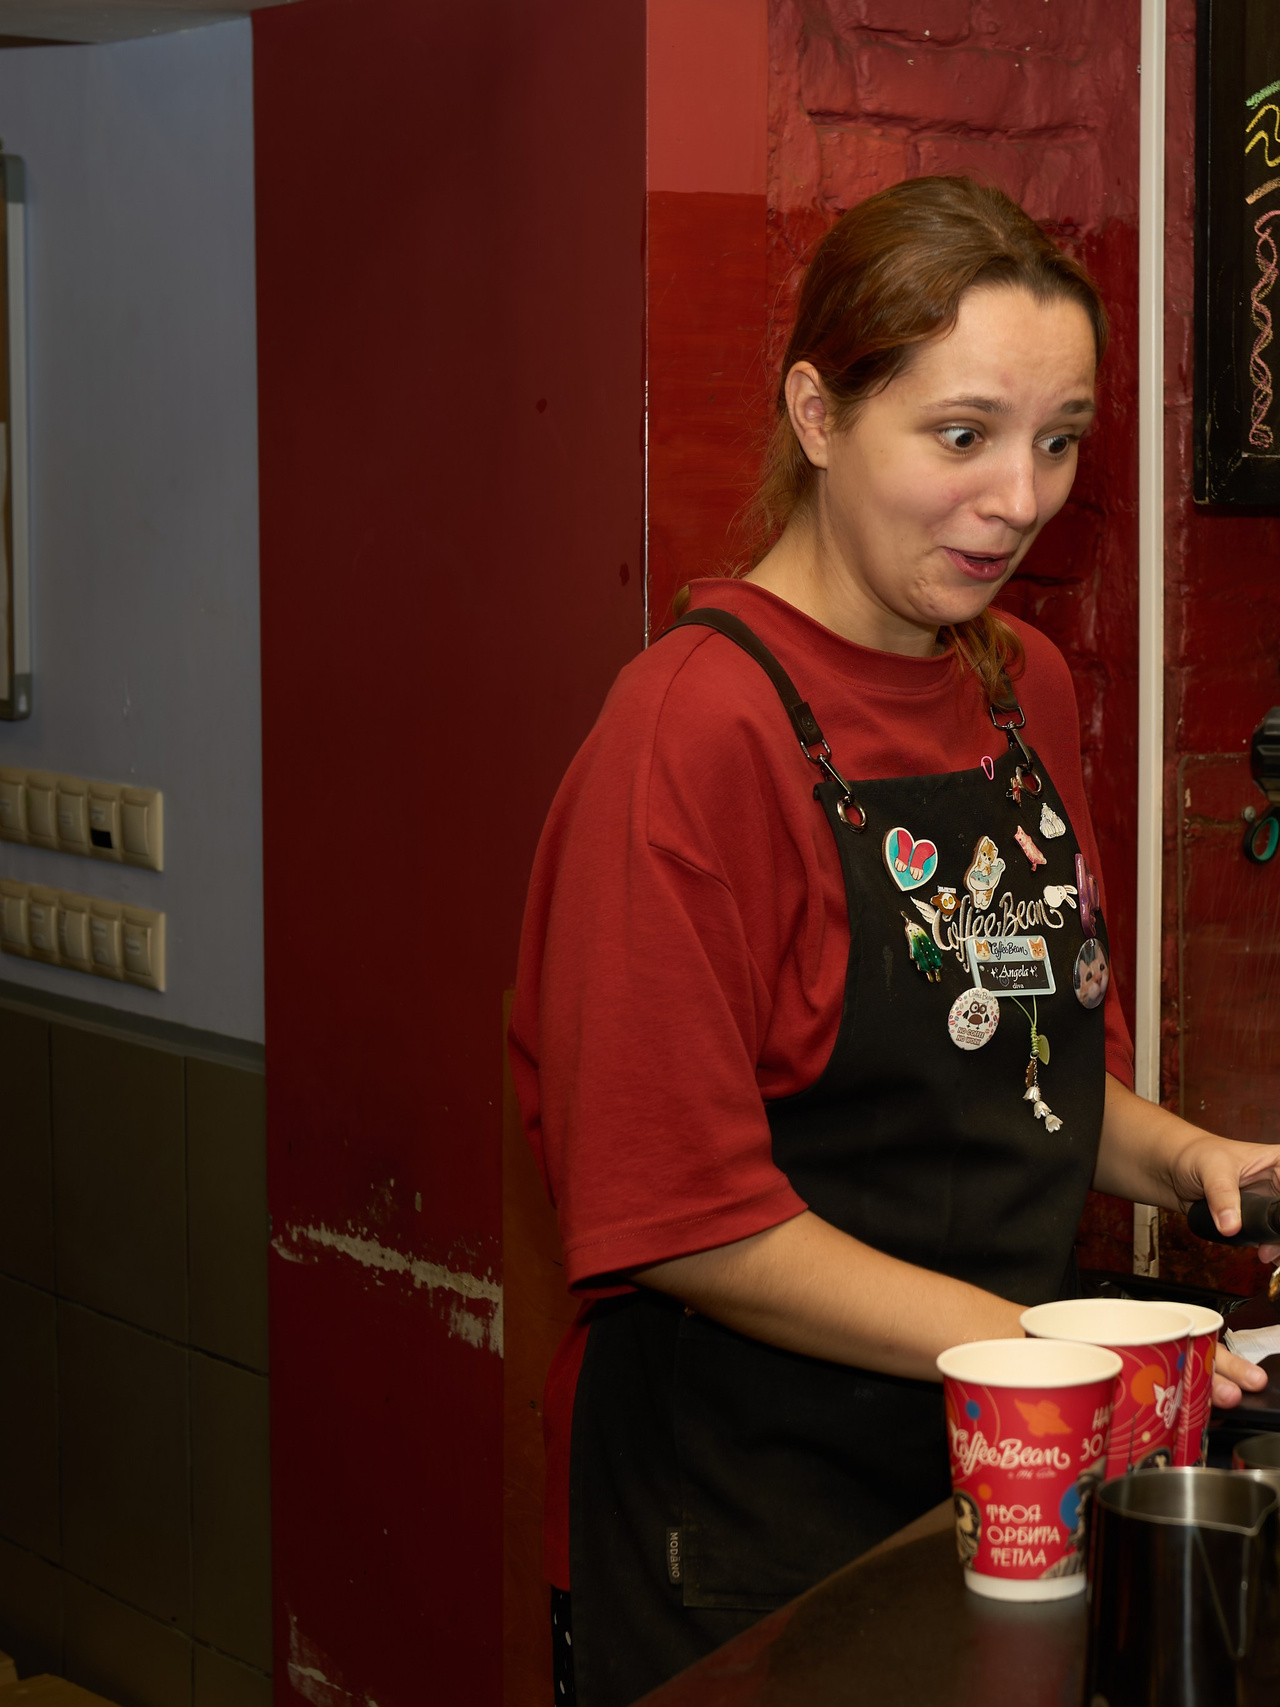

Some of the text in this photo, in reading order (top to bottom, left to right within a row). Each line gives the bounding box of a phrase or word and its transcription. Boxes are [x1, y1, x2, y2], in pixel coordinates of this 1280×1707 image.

[999, 964, 1030, 982] Angela
[956, 1034, 966, 1042] NO
[957, 1026, 967, 1034] NO
[985, 1503, 1043, 1524] ТВОЯ
[986, 1525, 1061, 1547] ОРБИТА
[990, 1547, 1048, 1568] ТЕПЛА
